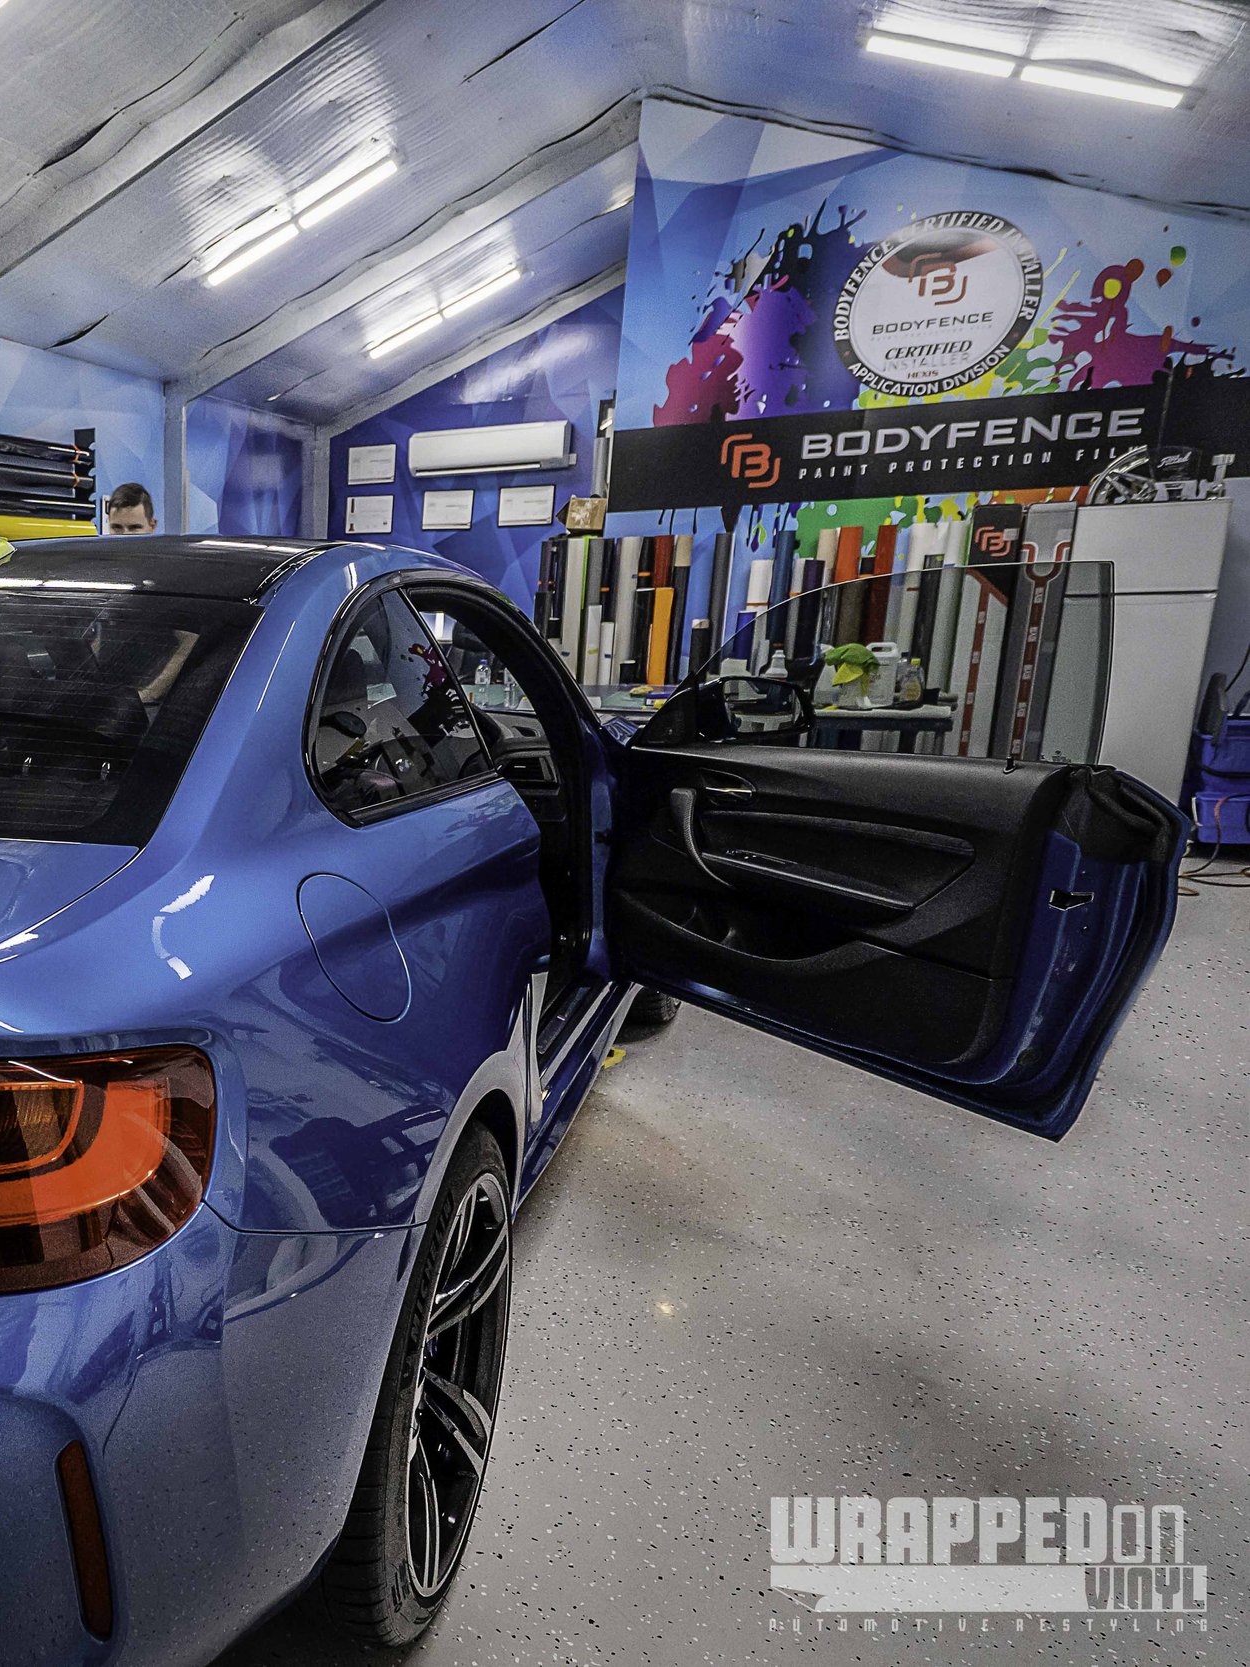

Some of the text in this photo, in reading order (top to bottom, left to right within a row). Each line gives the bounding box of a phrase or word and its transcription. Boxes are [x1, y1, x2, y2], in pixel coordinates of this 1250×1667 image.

[833, 240, 896, 342] BODYFENCE
[872, 311, 994, 335] BODYFENCE
[847, 343, 1013, 397] APPLICATION DIVISION
[884, 340, 973, 360] CERTIFIED
[799, 408, 1146, 460] BODYFENCE
[799, 446, 1140, 480] PAINT PROTECTION FIL
